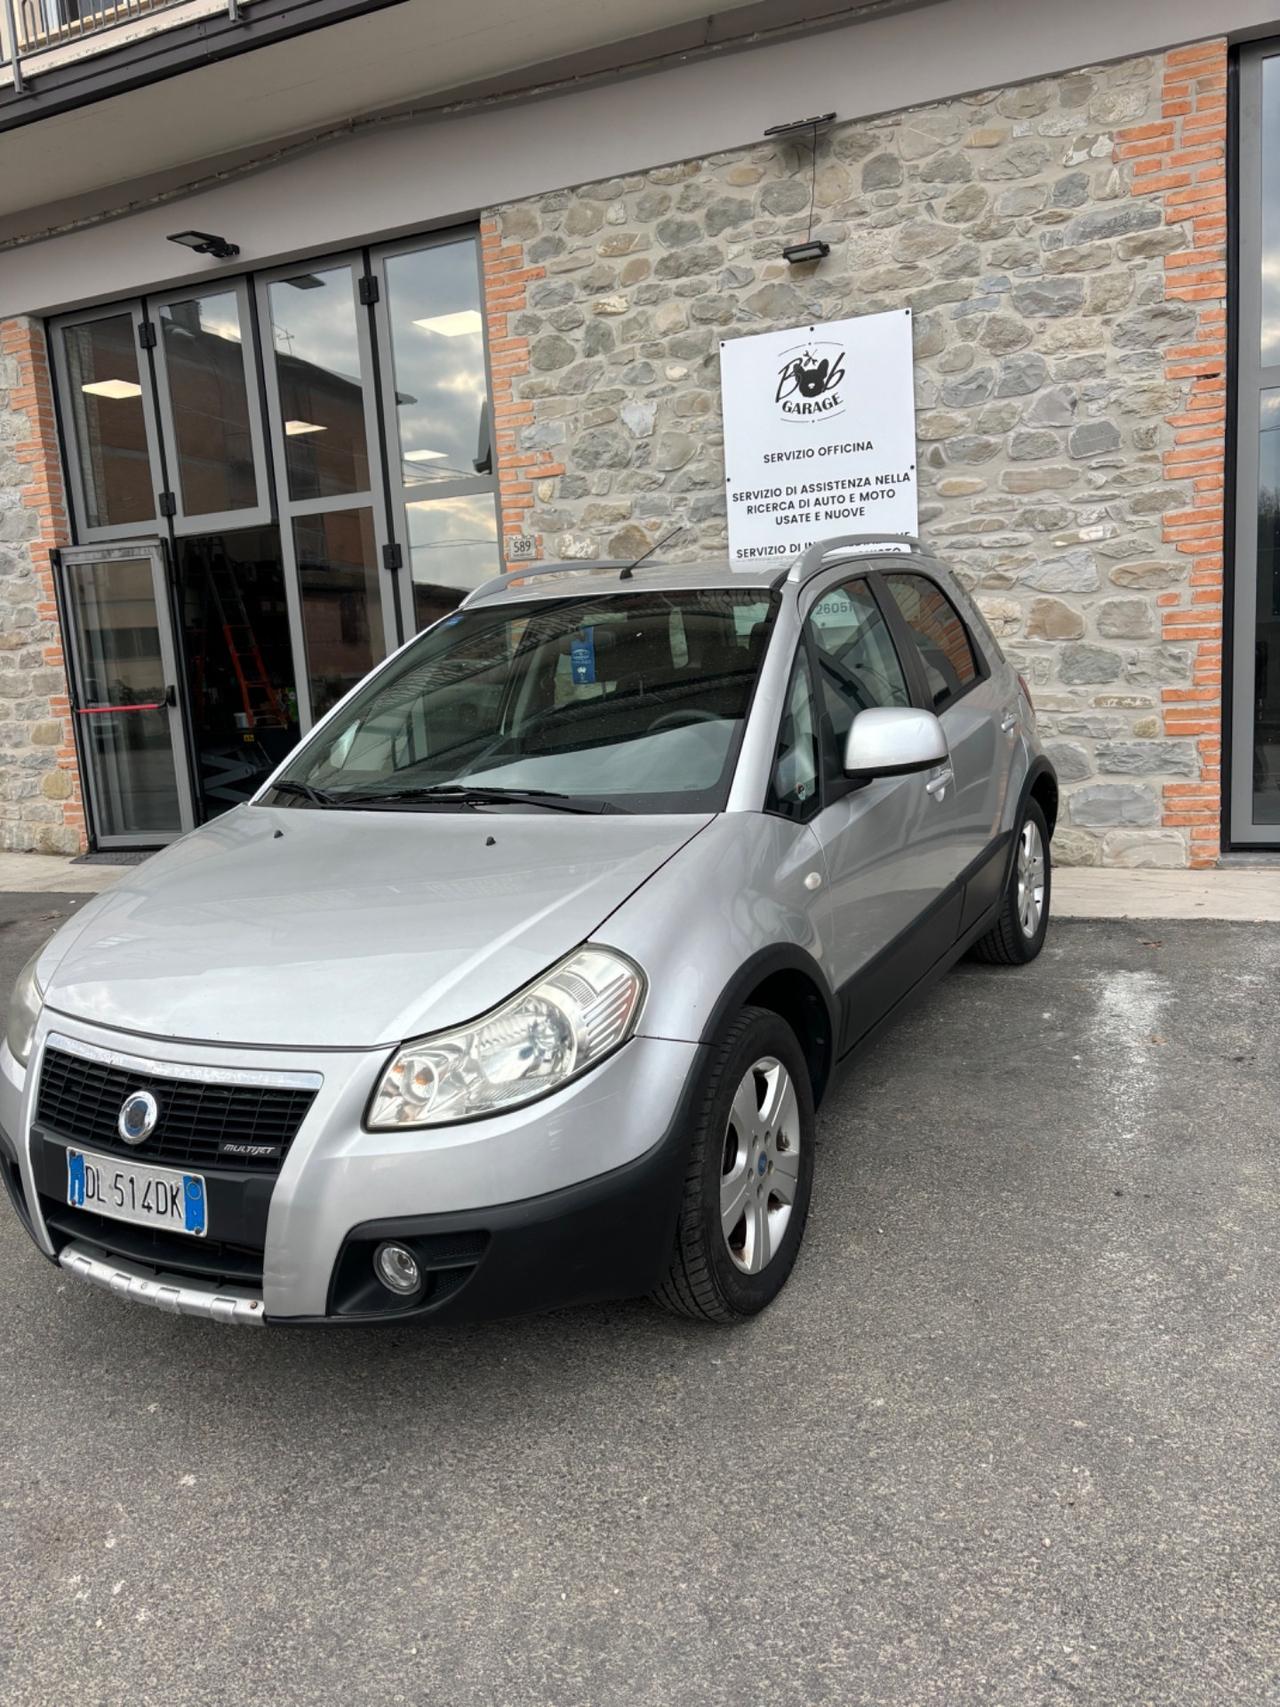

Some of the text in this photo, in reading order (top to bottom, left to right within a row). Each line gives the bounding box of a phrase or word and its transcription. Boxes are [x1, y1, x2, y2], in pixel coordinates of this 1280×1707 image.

[782, 392, 844, 415] GARAGE
[763, 440, 874, 464] SERVIZIO OFFICINA
[732, 472, 911, 503] SERVIZIO DI ASSISTENZA NELLA
[746, 488, 896, 515] RICERCA DI AUTO E MOTO
[775, 506, 866, 526] USATE E NUOVE
[513, 540, 532, 553] 589
[736, 542, 801, 559] SERVIZIO DI
[223, 1143, 276, 1156] MULTIJET
[85, 1164, 183, 1219] DL 514DK
